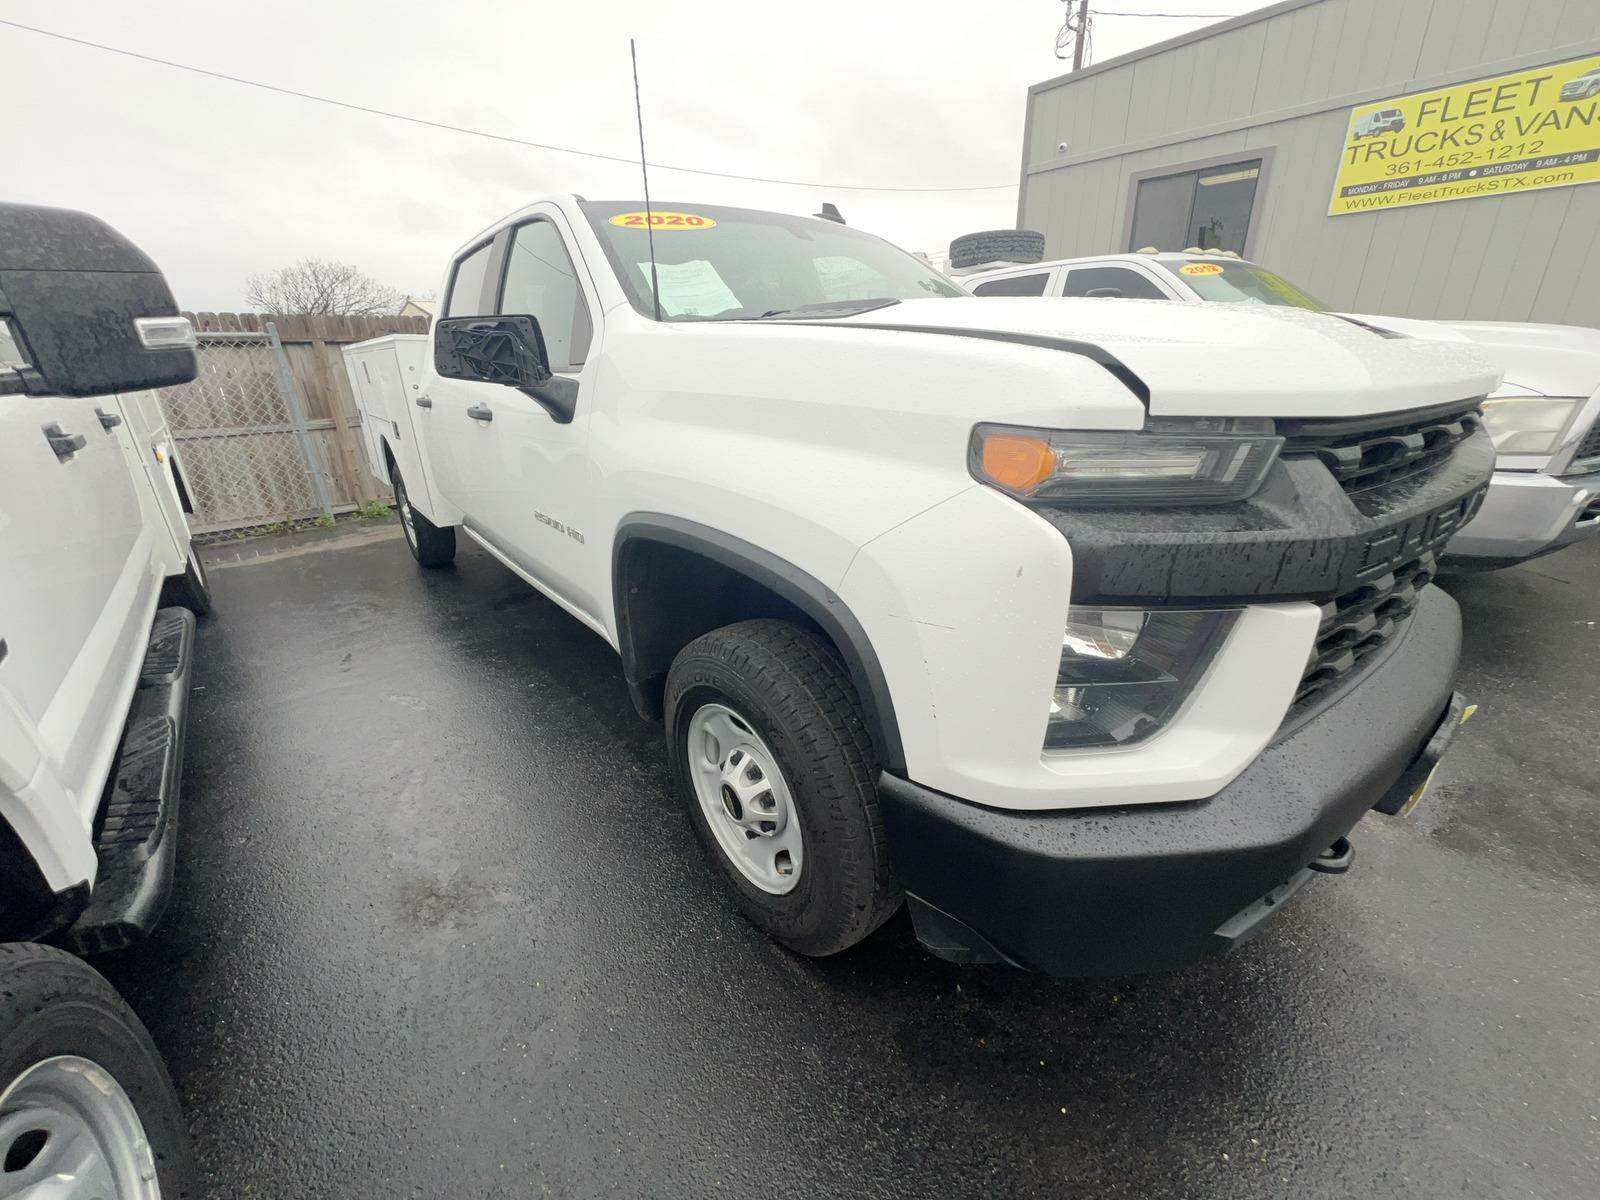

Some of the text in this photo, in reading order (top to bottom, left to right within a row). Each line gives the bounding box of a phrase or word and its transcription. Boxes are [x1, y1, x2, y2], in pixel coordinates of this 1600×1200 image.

[1416, 75, 1553, 128] FLEET
[1347, 101, 1600, 165] TRUCKS & VAN
[1383, 179, 1410, 190] FRIDAY
[1482, 161, 1529, 176] SATURDAY
[1384, 140, 1545, 177] 361-452-1212
[624, 215, 705, 226] 2020
